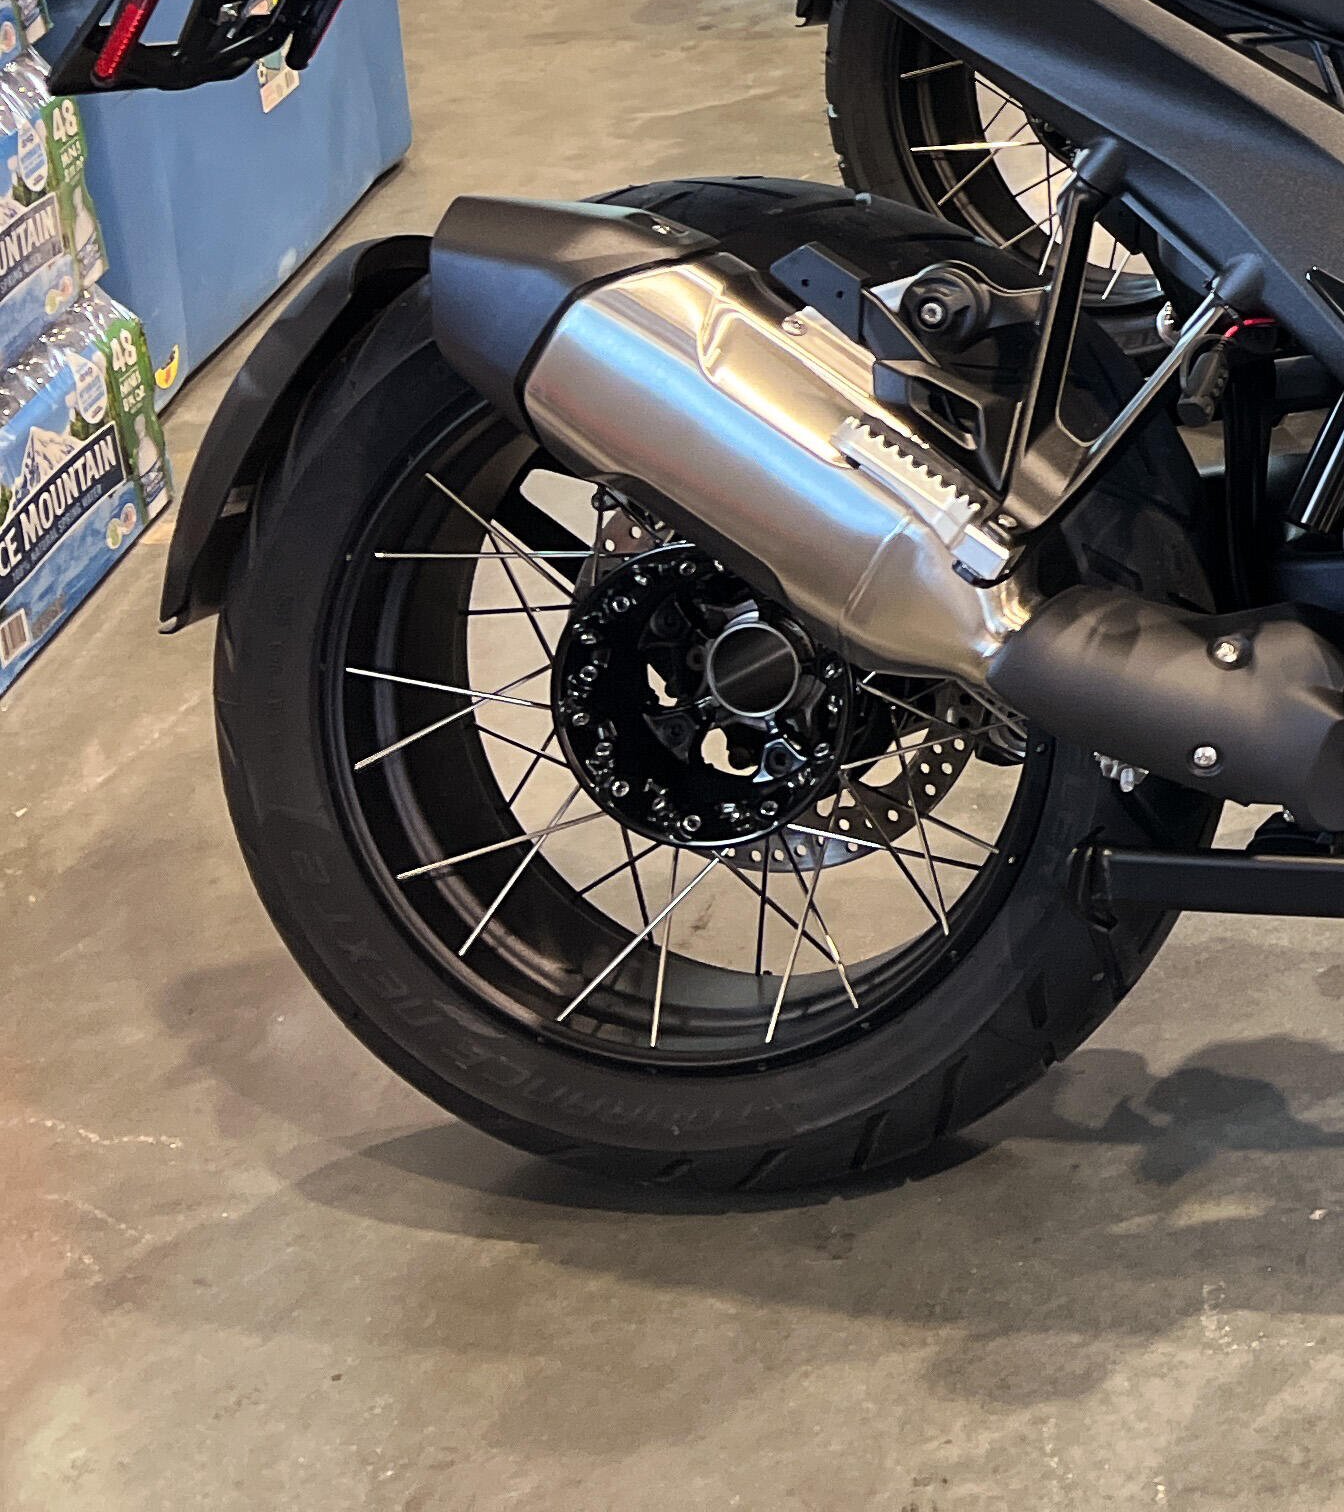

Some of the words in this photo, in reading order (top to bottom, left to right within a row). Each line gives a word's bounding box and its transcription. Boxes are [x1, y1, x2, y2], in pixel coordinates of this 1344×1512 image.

[52, 99, 78, 142] 48
[110, 328, 138, 372] 48
[19, 435, 117, 551] MOUNTAIN
